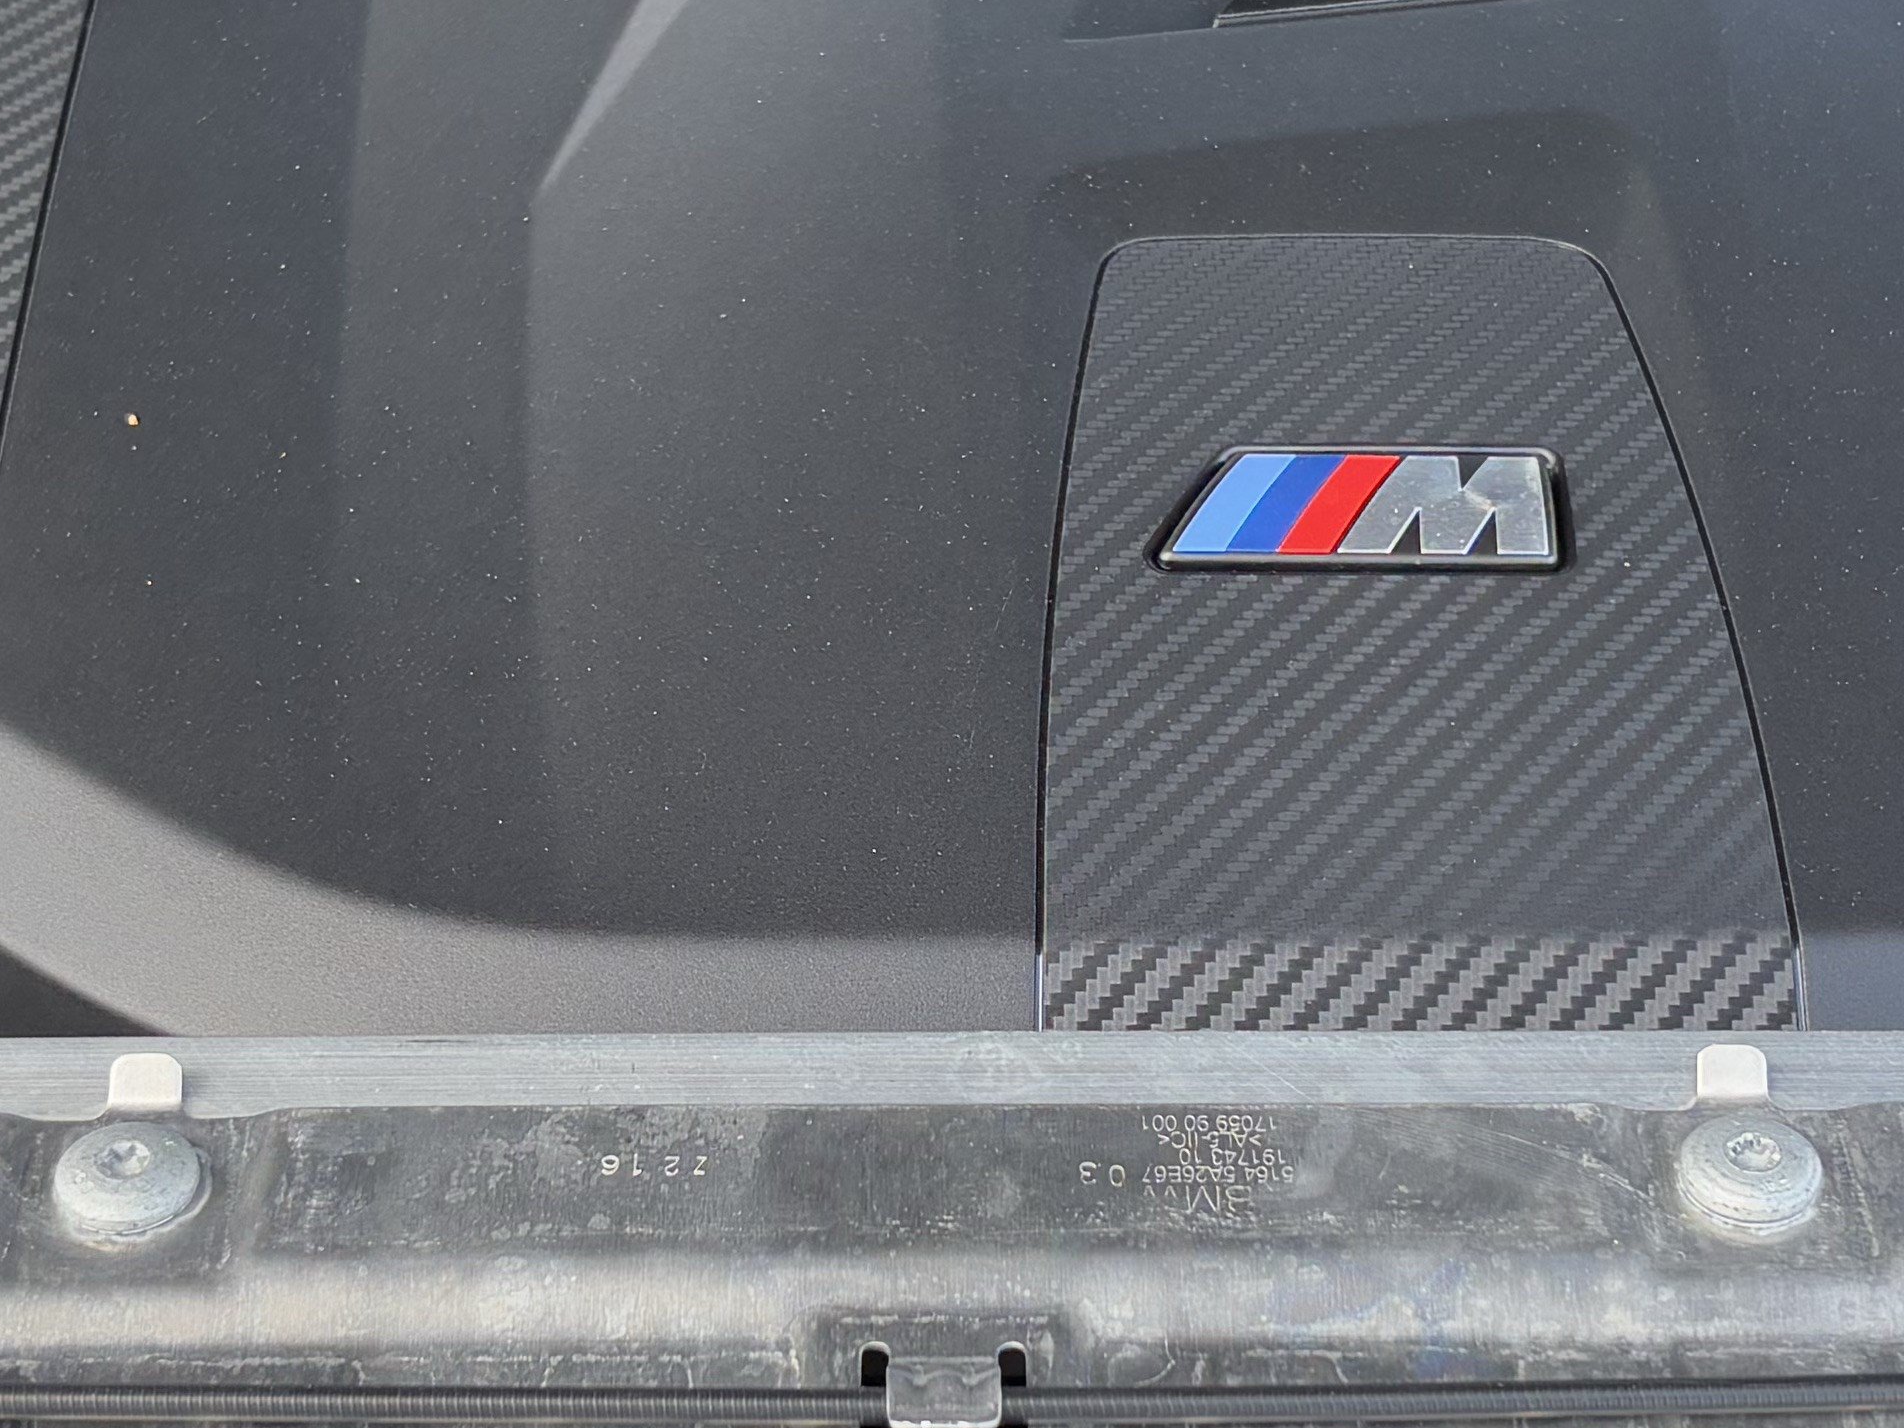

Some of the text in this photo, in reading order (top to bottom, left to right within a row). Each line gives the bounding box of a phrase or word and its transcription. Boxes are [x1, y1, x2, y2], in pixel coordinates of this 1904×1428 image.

[1336, 455, 1549, 556] M
[1141, 1114, 1277, 1132] 17059 90 001
[1179, 1148, 1286, 1166] 191743 10
